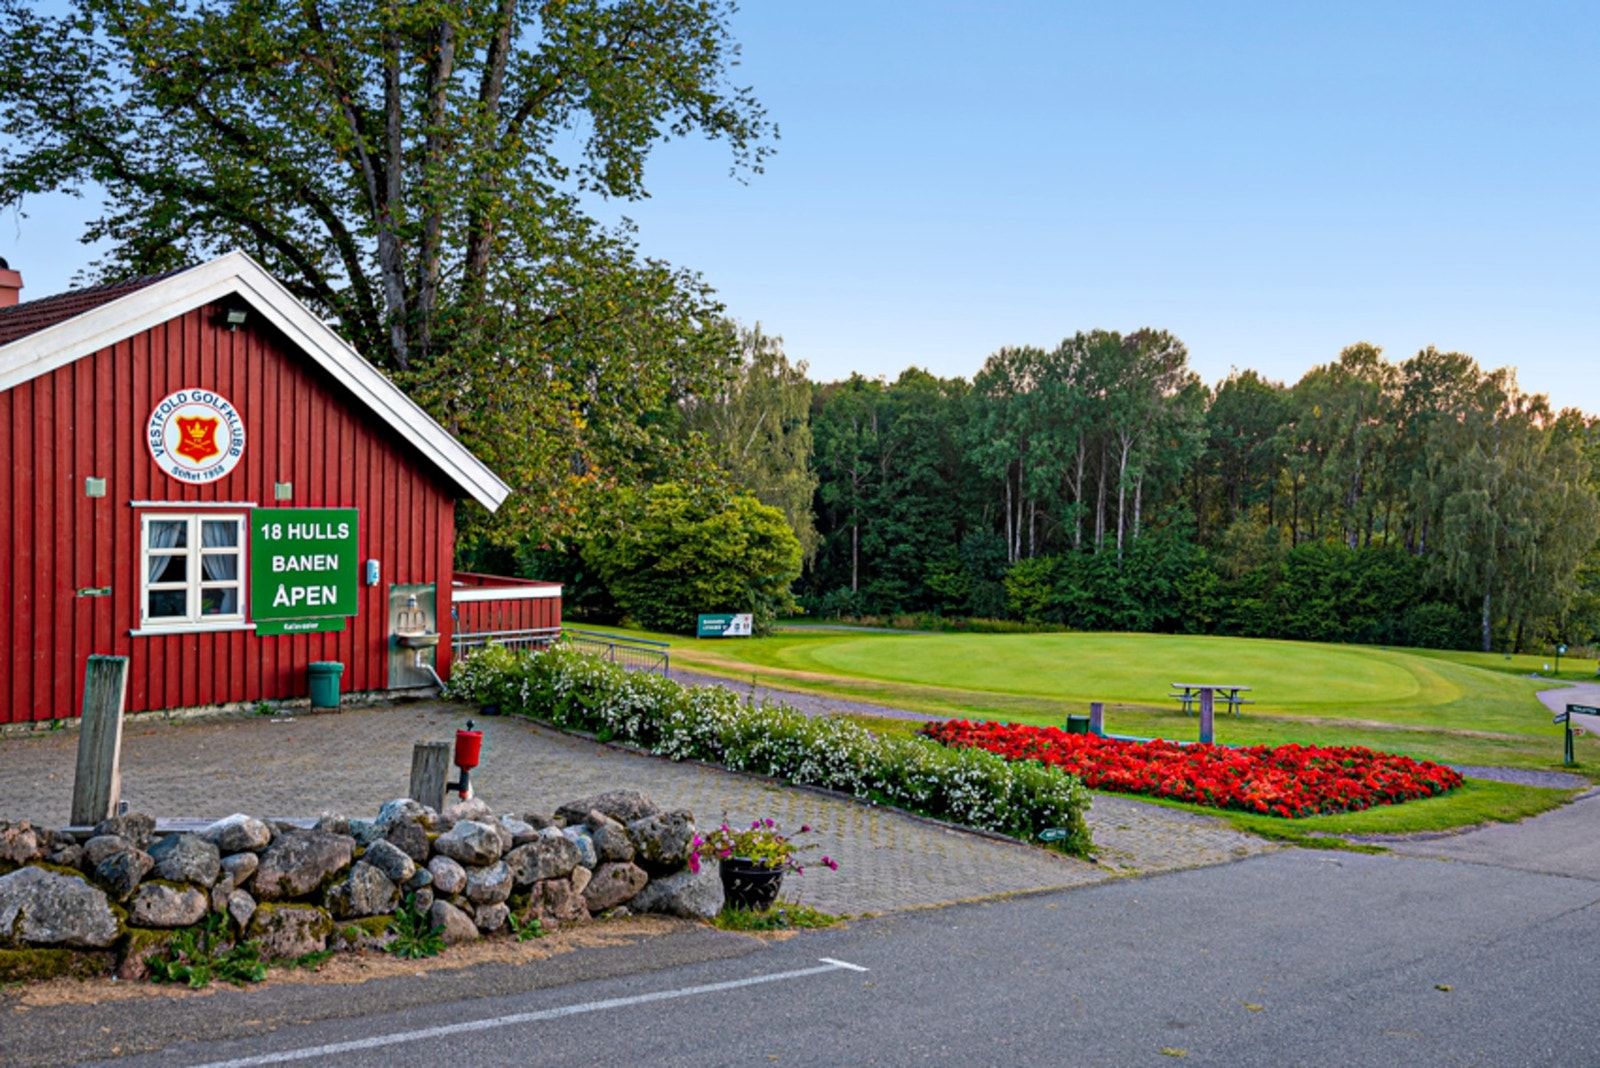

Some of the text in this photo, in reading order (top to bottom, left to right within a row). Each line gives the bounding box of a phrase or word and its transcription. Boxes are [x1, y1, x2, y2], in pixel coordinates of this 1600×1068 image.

[150, 390, 243, 458] VESTFOLD GOLFKLUBB
[261, 522, 350, 540] 18 HULLS
[272, 554, 339, 572] BANEN
[272, 583, 338, 608] ÅPEN
